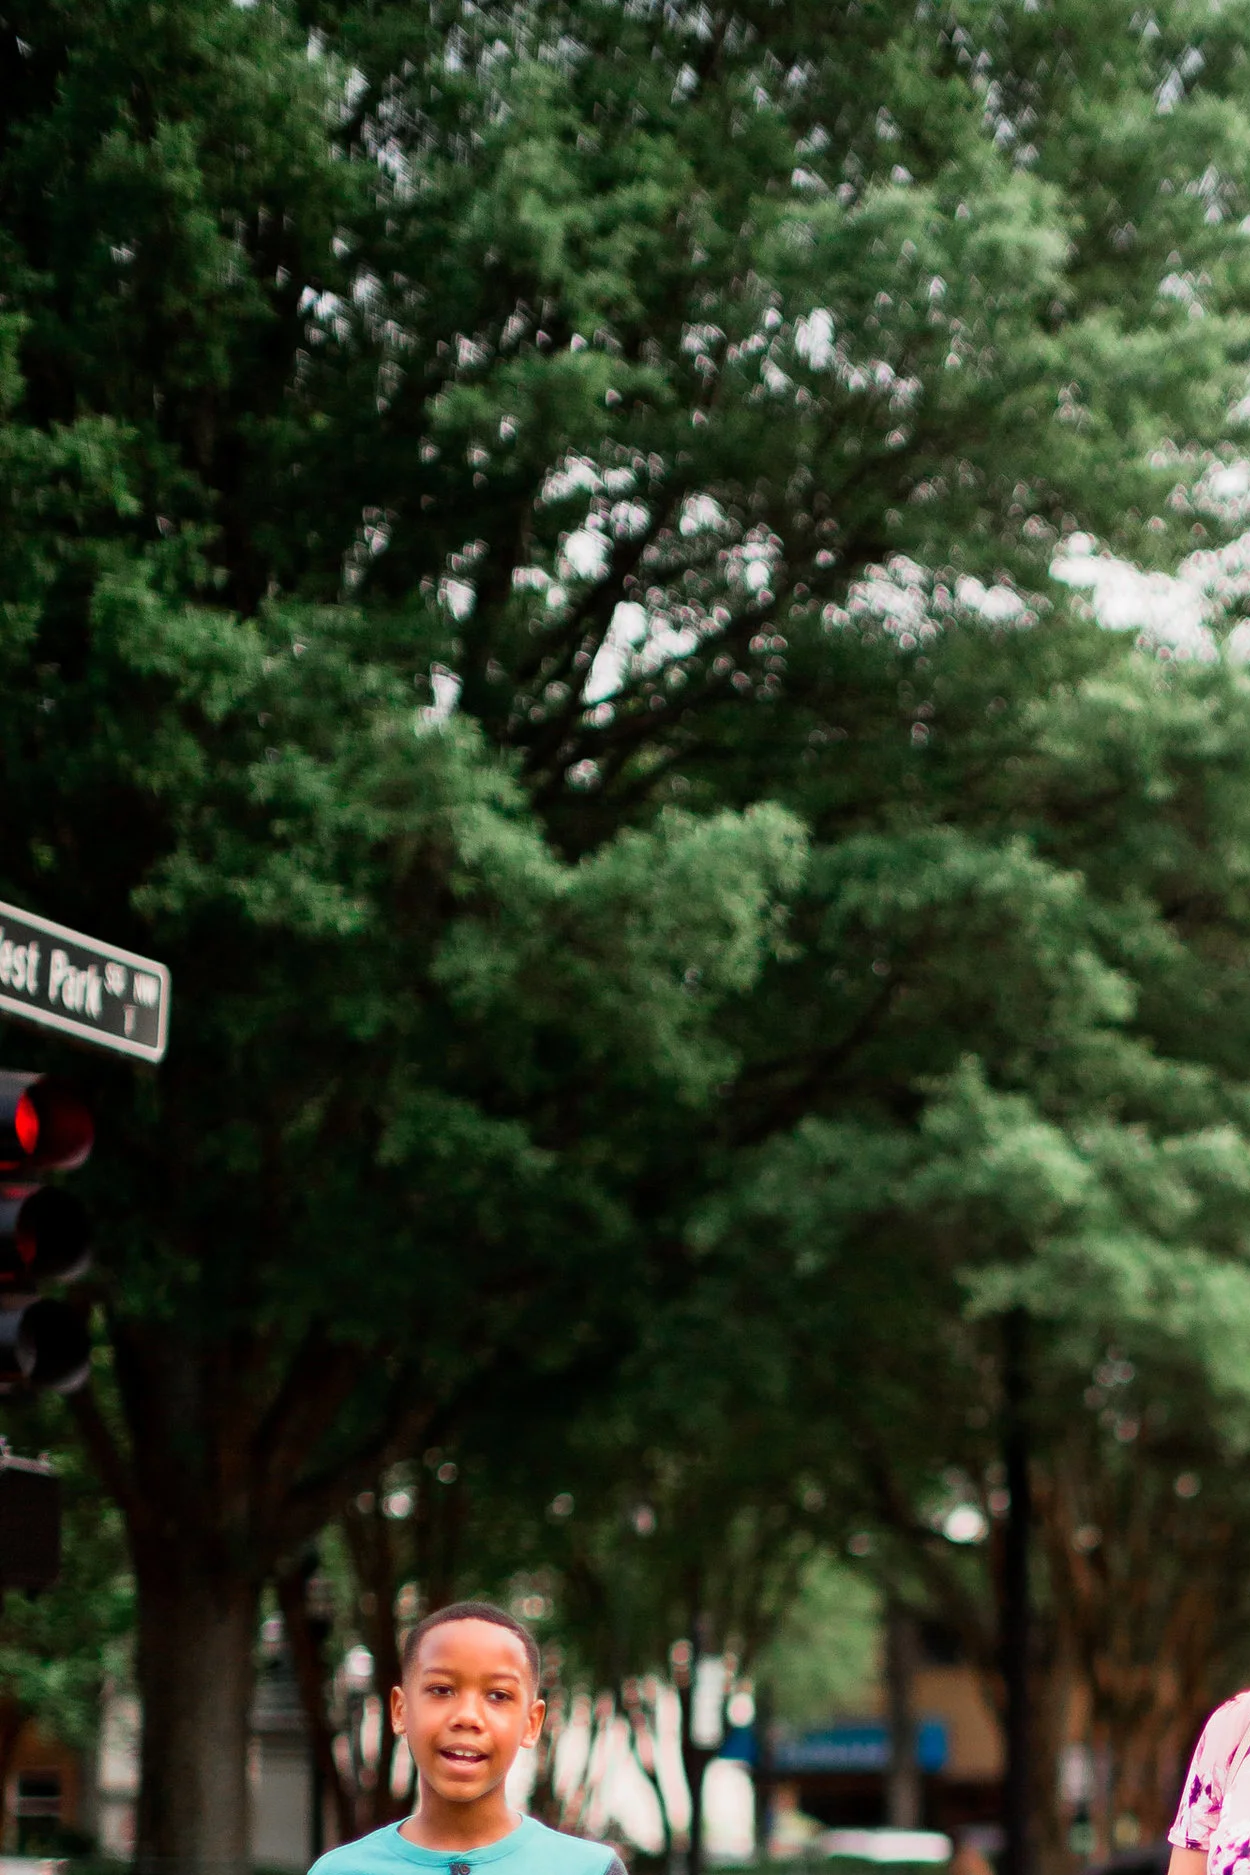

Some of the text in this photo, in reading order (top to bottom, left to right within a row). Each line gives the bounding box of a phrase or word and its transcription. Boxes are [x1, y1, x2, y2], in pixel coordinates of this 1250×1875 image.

[0, 927, 39, 996] est
[49, 949, 102, 1020] Park
[133, 971, 159, 1008] NW
